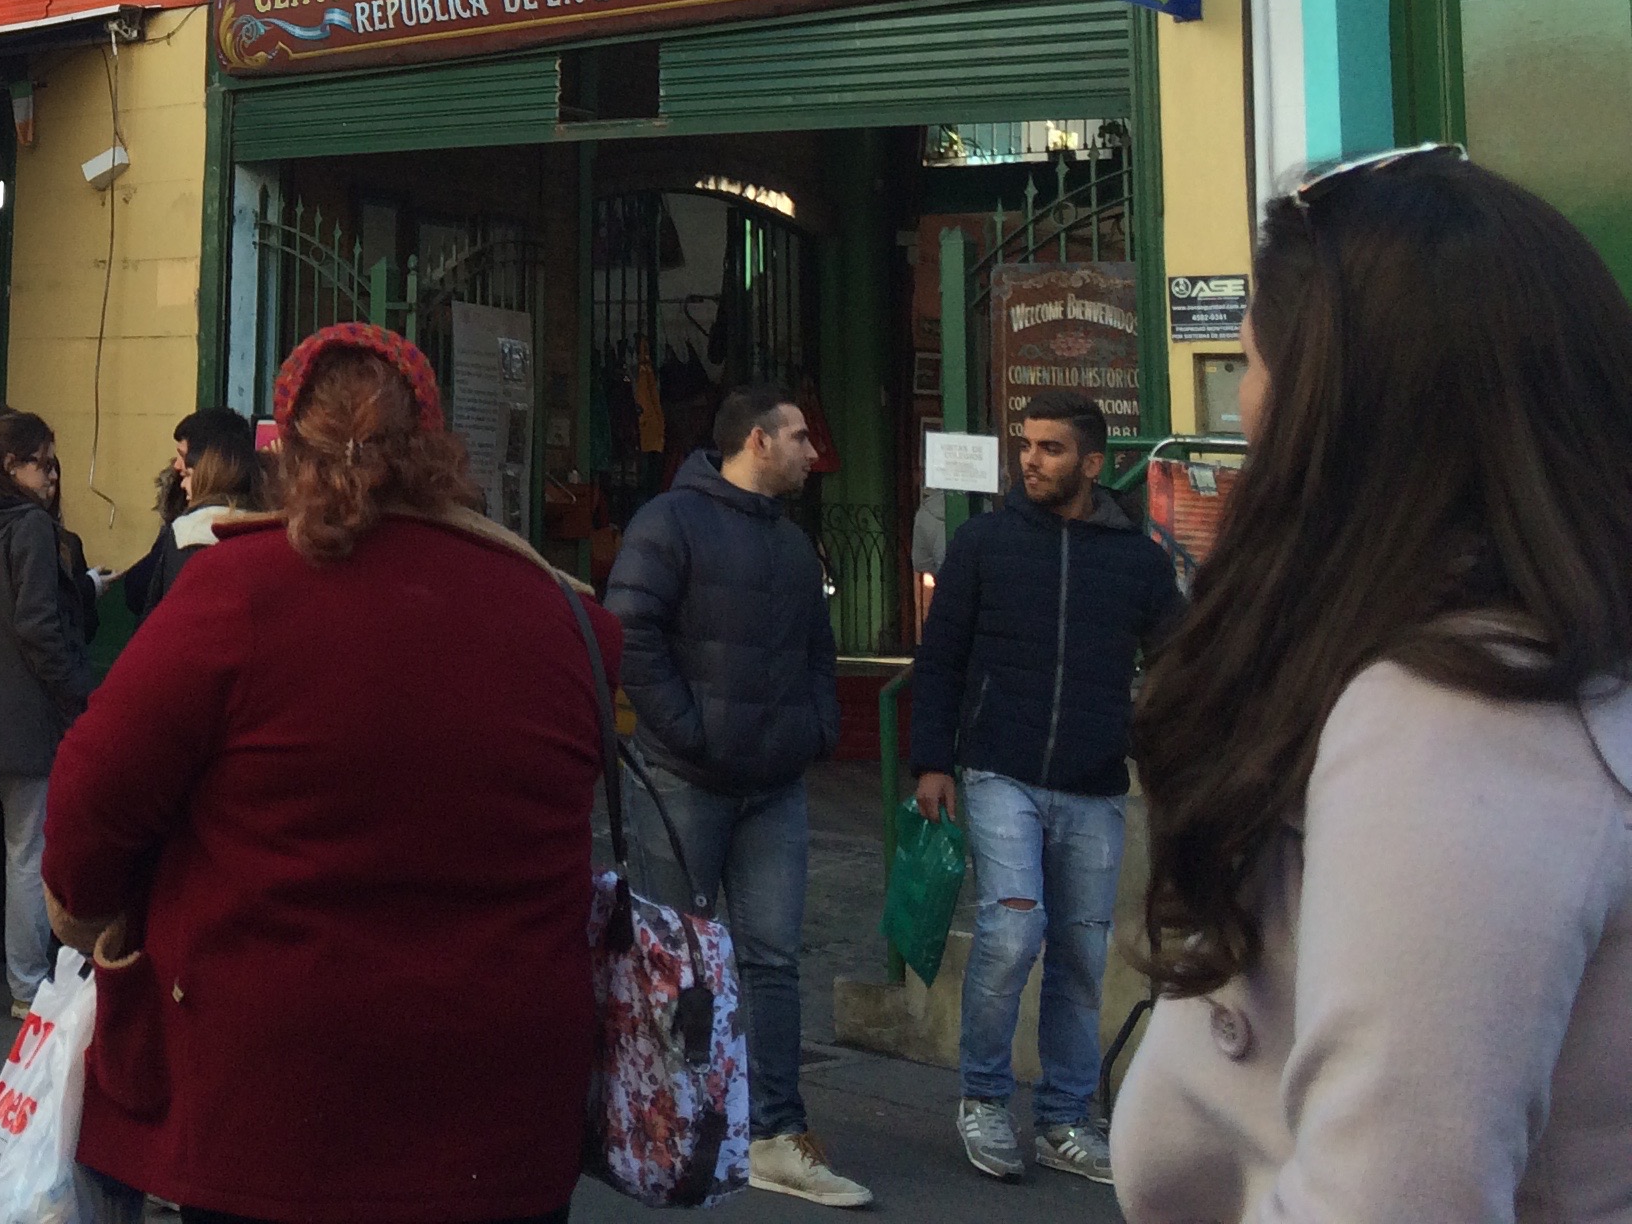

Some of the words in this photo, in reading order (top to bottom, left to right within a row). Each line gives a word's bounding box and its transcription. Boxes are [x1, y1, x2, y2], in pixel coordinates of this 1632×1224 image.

[1190, 279, 1246, 297] ASE
[1010, 299, 1065, 333] WELCOME
[1008, 365, 1079, 387] CONVENTILLO
